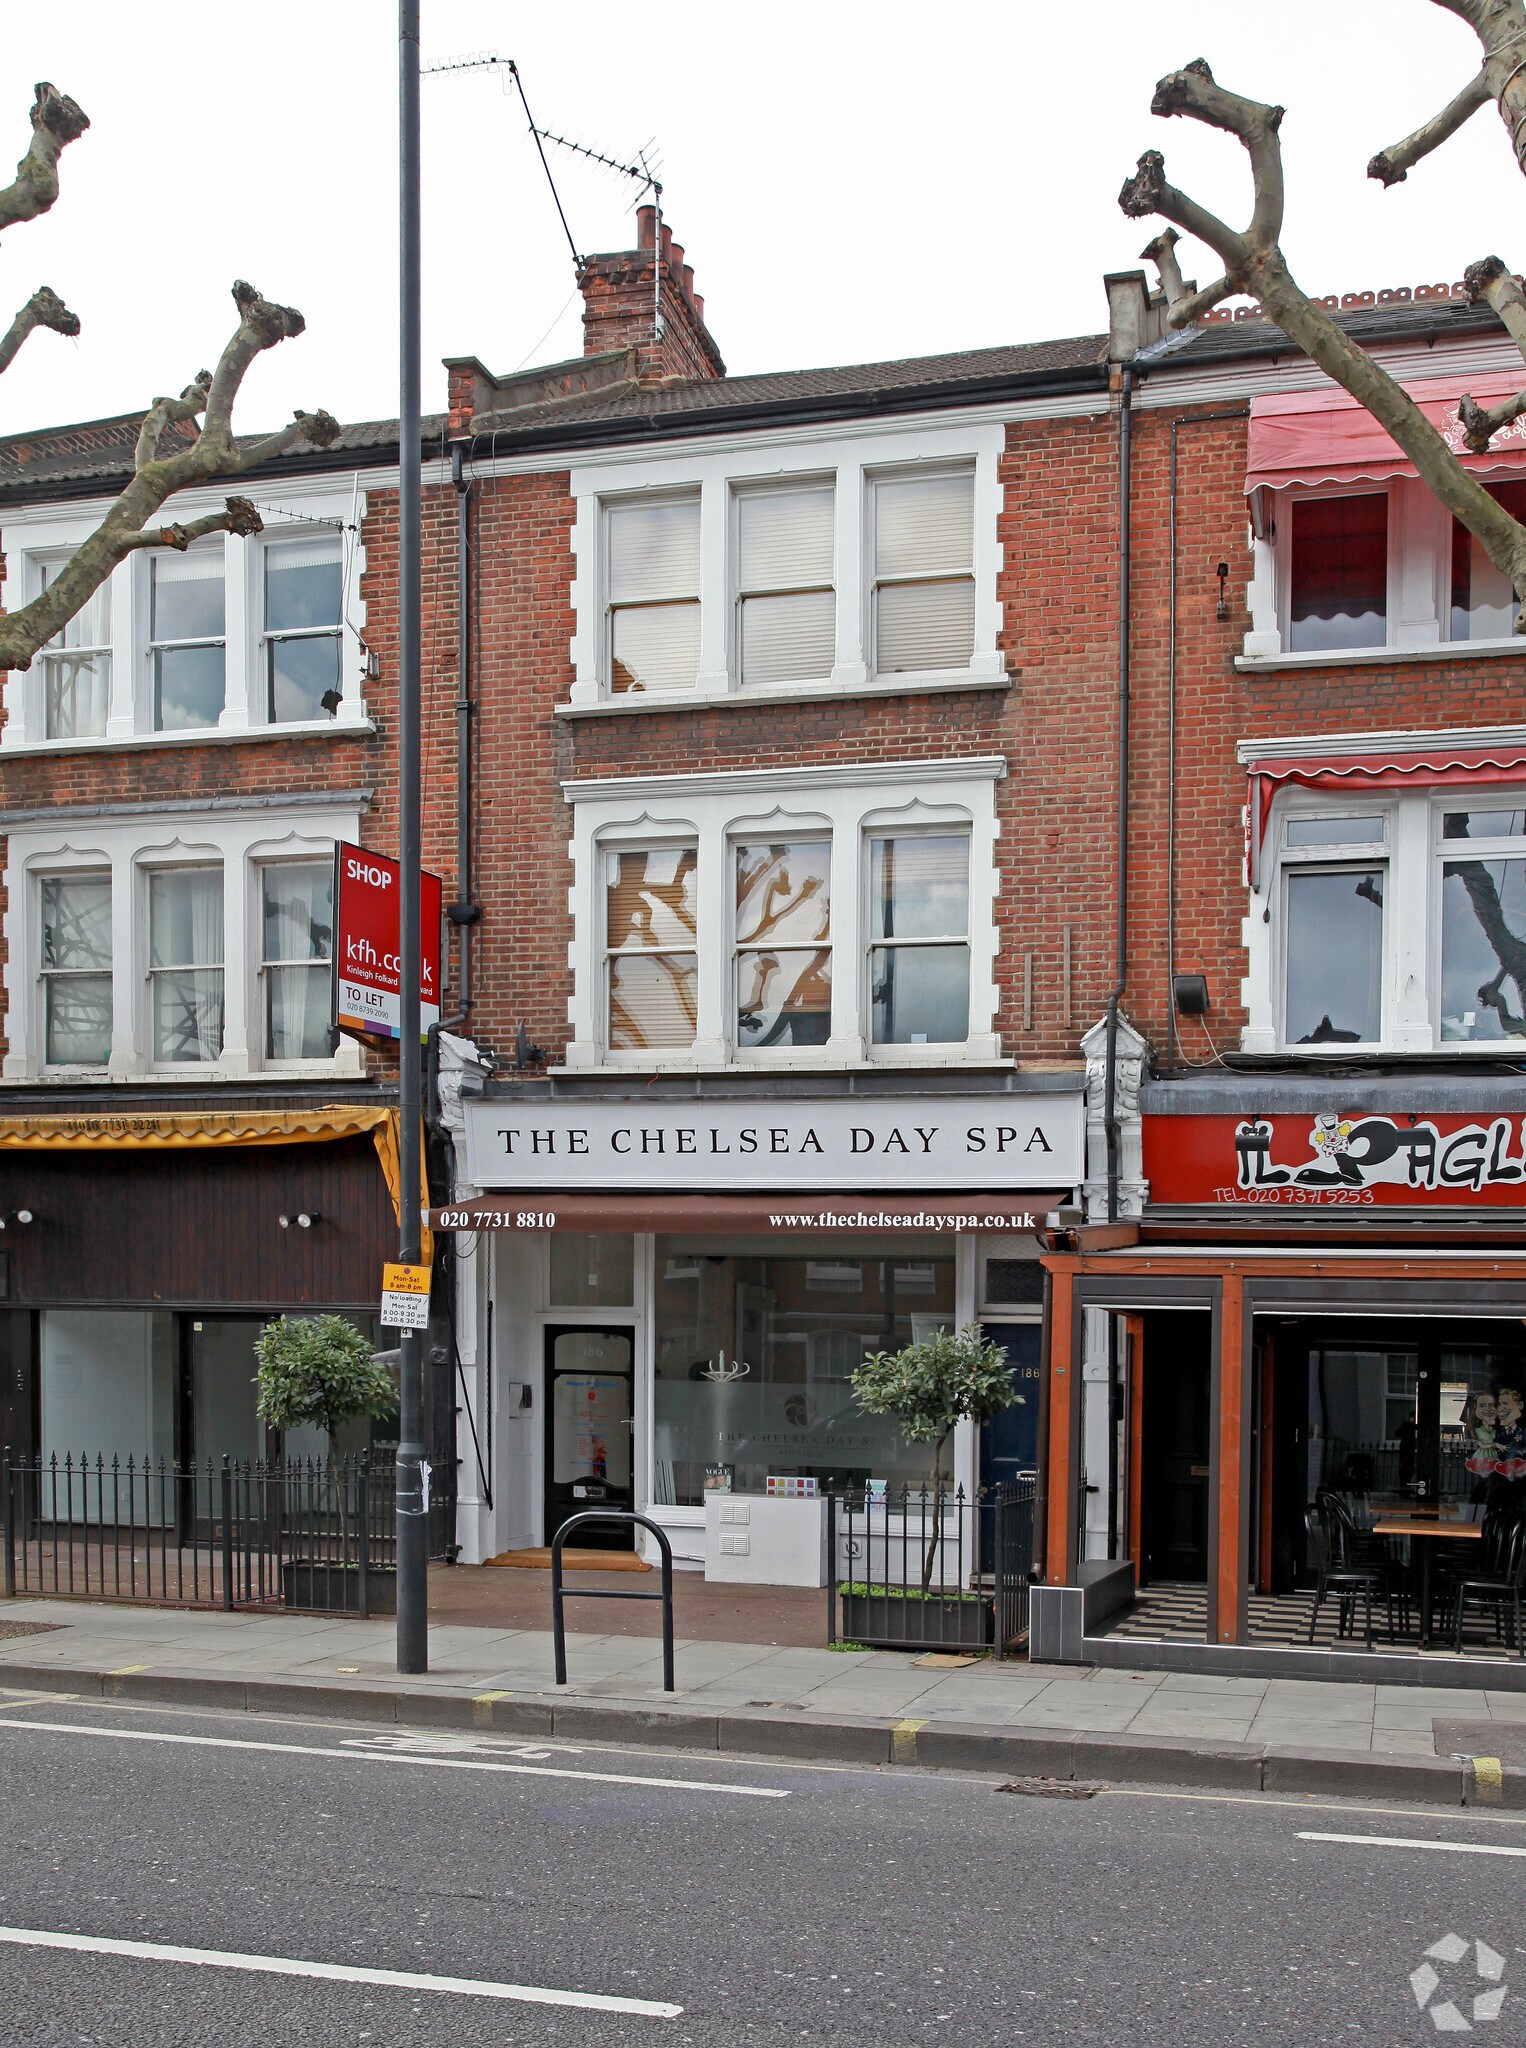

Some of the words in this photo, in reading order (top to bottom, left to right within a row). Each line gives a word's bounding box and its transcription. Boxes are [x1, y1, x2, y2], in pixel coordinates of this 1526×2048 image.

[347, 859, 392, 889] SHOP
[347, 934, 432, 982] kfh.cok
[346, 964, 374, 980] Kinleigh
[374, 972, 398, 986] Folkard
[346, 986, 361, 1001] TO
[365, 991, 385, 1007] LET
[346, 1002, 359, 1011] 020
[359, 1005, 374, 1015] 8739
[374, 1011, 389, 1019] 2090
[497, 1129, 590, 1154] THE
[611, 1127, 825, 1154] CHELSEA
[850, 1127, 939, 1153] DAY
[966, 1126, 1053, 1153] SPA
[1241, 1125, 1291, 1185] IL
[1294, 1120, 1526, 1190] PAGL
[1213, 1187, 1247, 1202] TEL.
[1248, 1188, 1280, 1203] 020
[1283, 1188, 1322, 1204] 7371
[1326, 1189, 1374, 1204] 5253
[440, 1212, 469, 1227] 020
[473, 1212, 511, 1227] 7731
[516, 1212, 556, 1228] 8810
[769, 1212, 1036, 1231] www.thechelseadayspa.co.uk
[394, 1275, 420, 1283] Mon-Sat
[392, 1302, 418, 1310] Mon-Sat
[400, 1295, 422, 1303] loading
[402, 1327, 409, 1336] 4
[583, 1347, 603, 1357] 186
[1021, 1367, 1040, 1379] 186
[752, 1432, 818, 1444] CHELSEA
[826, 1435, 854, 1446] DAY
